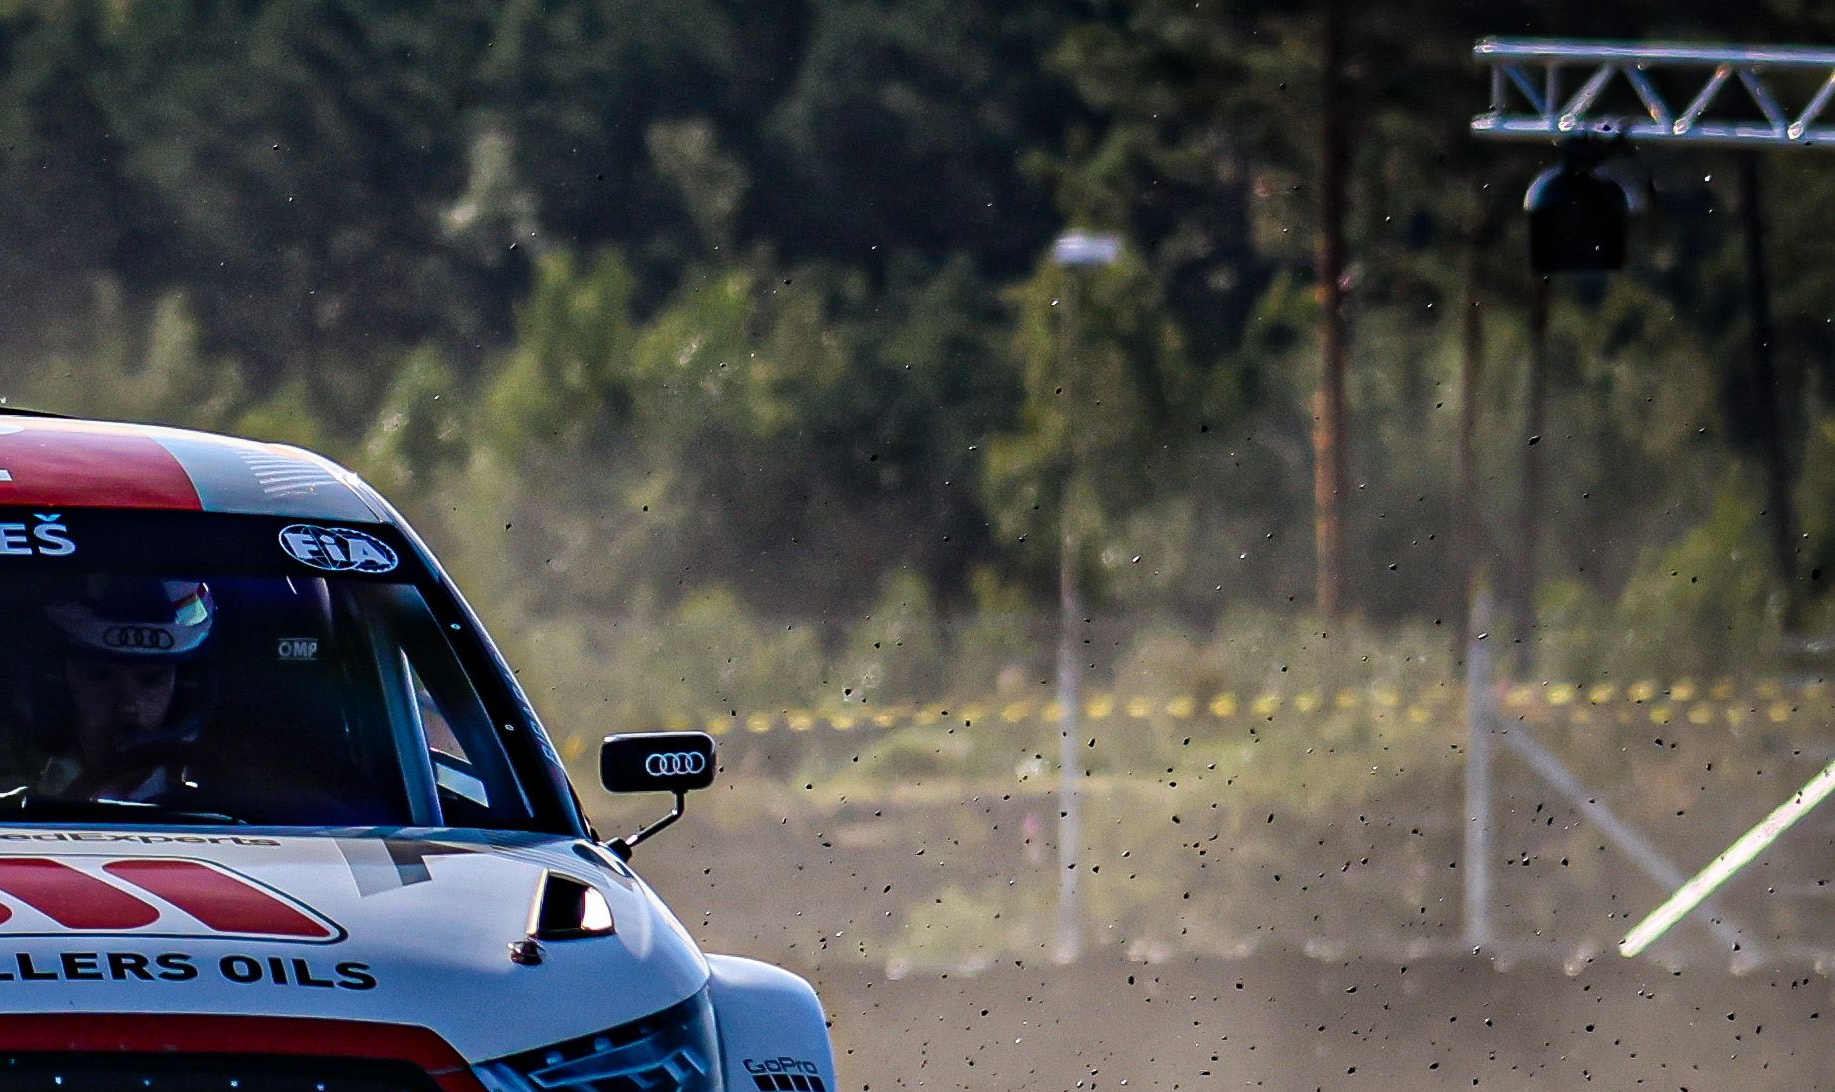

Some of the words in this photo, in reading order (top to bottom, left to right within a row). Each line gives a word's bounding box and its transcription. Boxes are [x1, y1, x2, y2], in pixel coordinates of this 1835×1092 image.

[278, 641, 317, 657] OMP
[218, 955, 377, 991] OILS
[742, 1056, 819, 1075] GoPro
